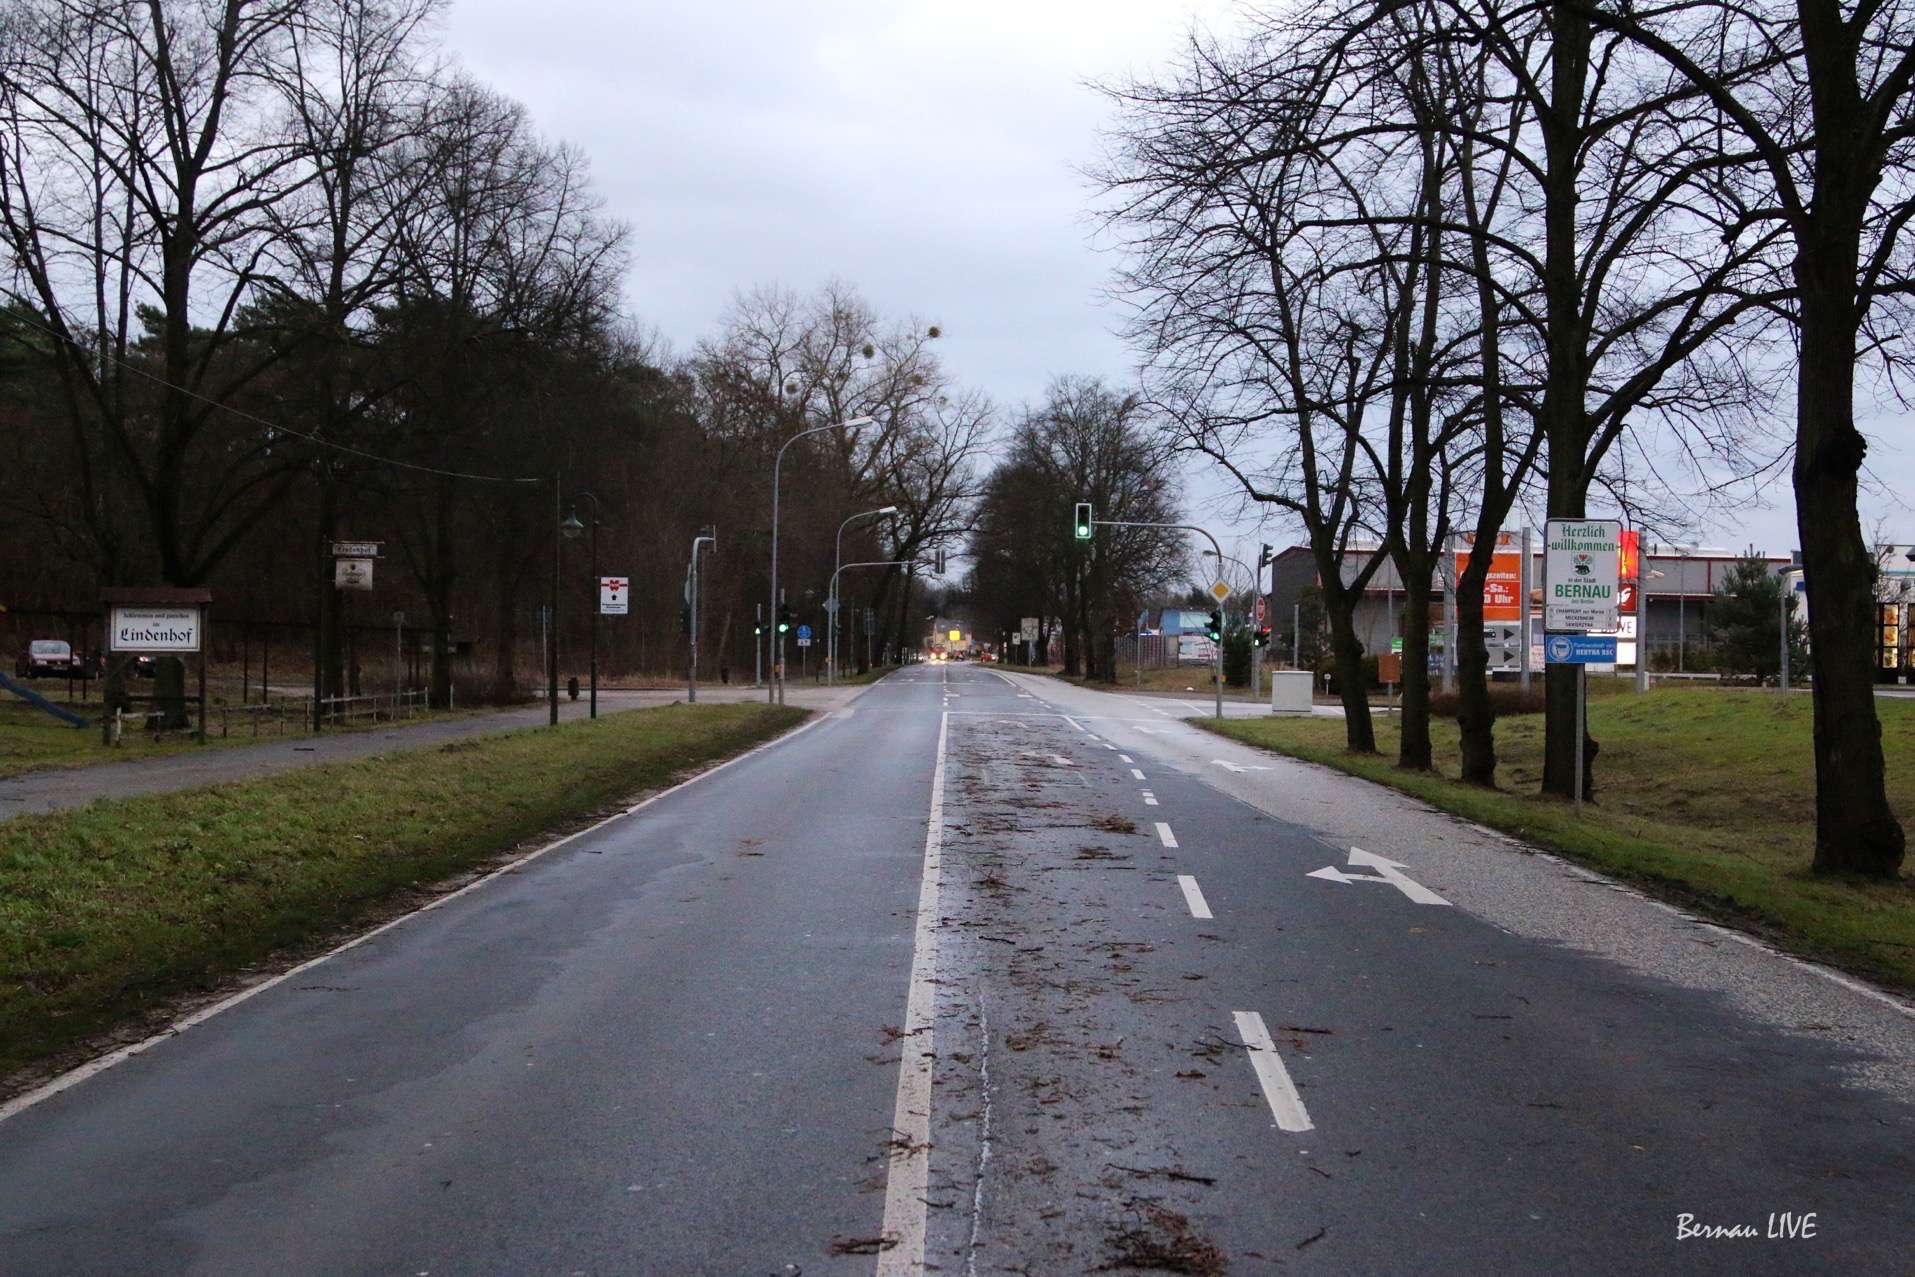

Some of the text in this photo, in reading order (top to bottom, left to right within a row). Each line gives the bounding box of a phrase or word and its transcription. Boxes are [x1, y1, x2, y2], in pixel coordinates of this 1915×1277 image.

[1561, 523, 1605, 538] Herzlich
[1551, 539, 1615, 551] willkommen
[1555, 584, 1611, 598] BERNAU
[1494, 594, 1514, 604] Uhr
[121, 628, 193, 644] Lindenhof
